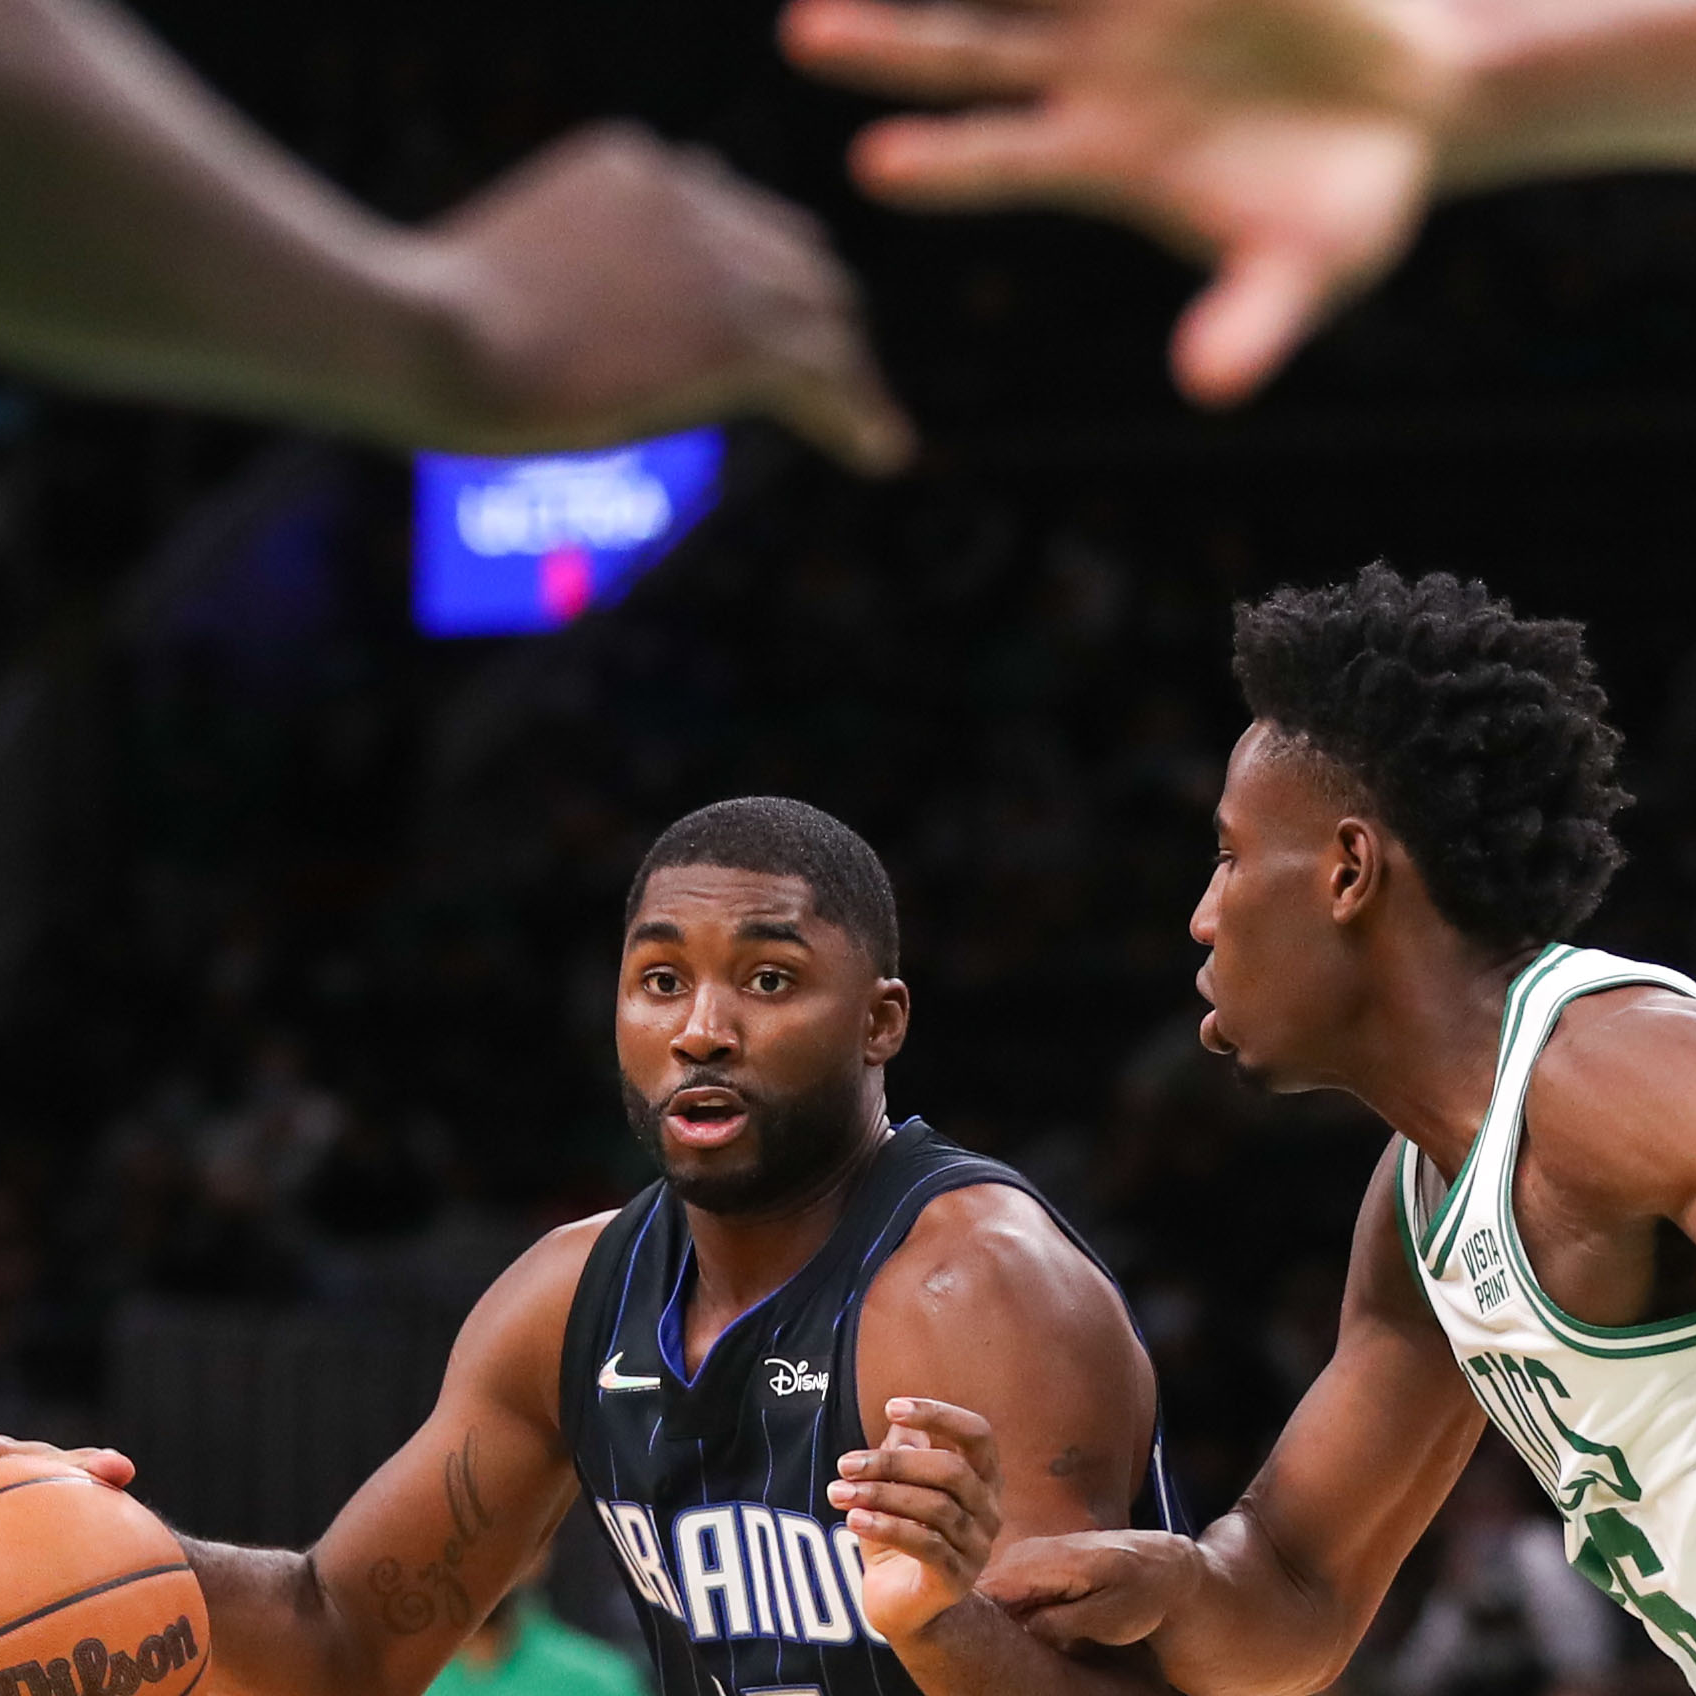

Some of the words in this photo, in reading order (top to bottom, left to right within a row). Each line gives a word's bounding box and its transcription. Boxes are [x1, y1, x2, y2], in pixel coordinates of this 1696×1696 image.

[1461, 1227, 1503, 1282] VISTA
[1474, 1268, 1511, 1315] PRINT
[764, 1357, 830, 1402] Disny
